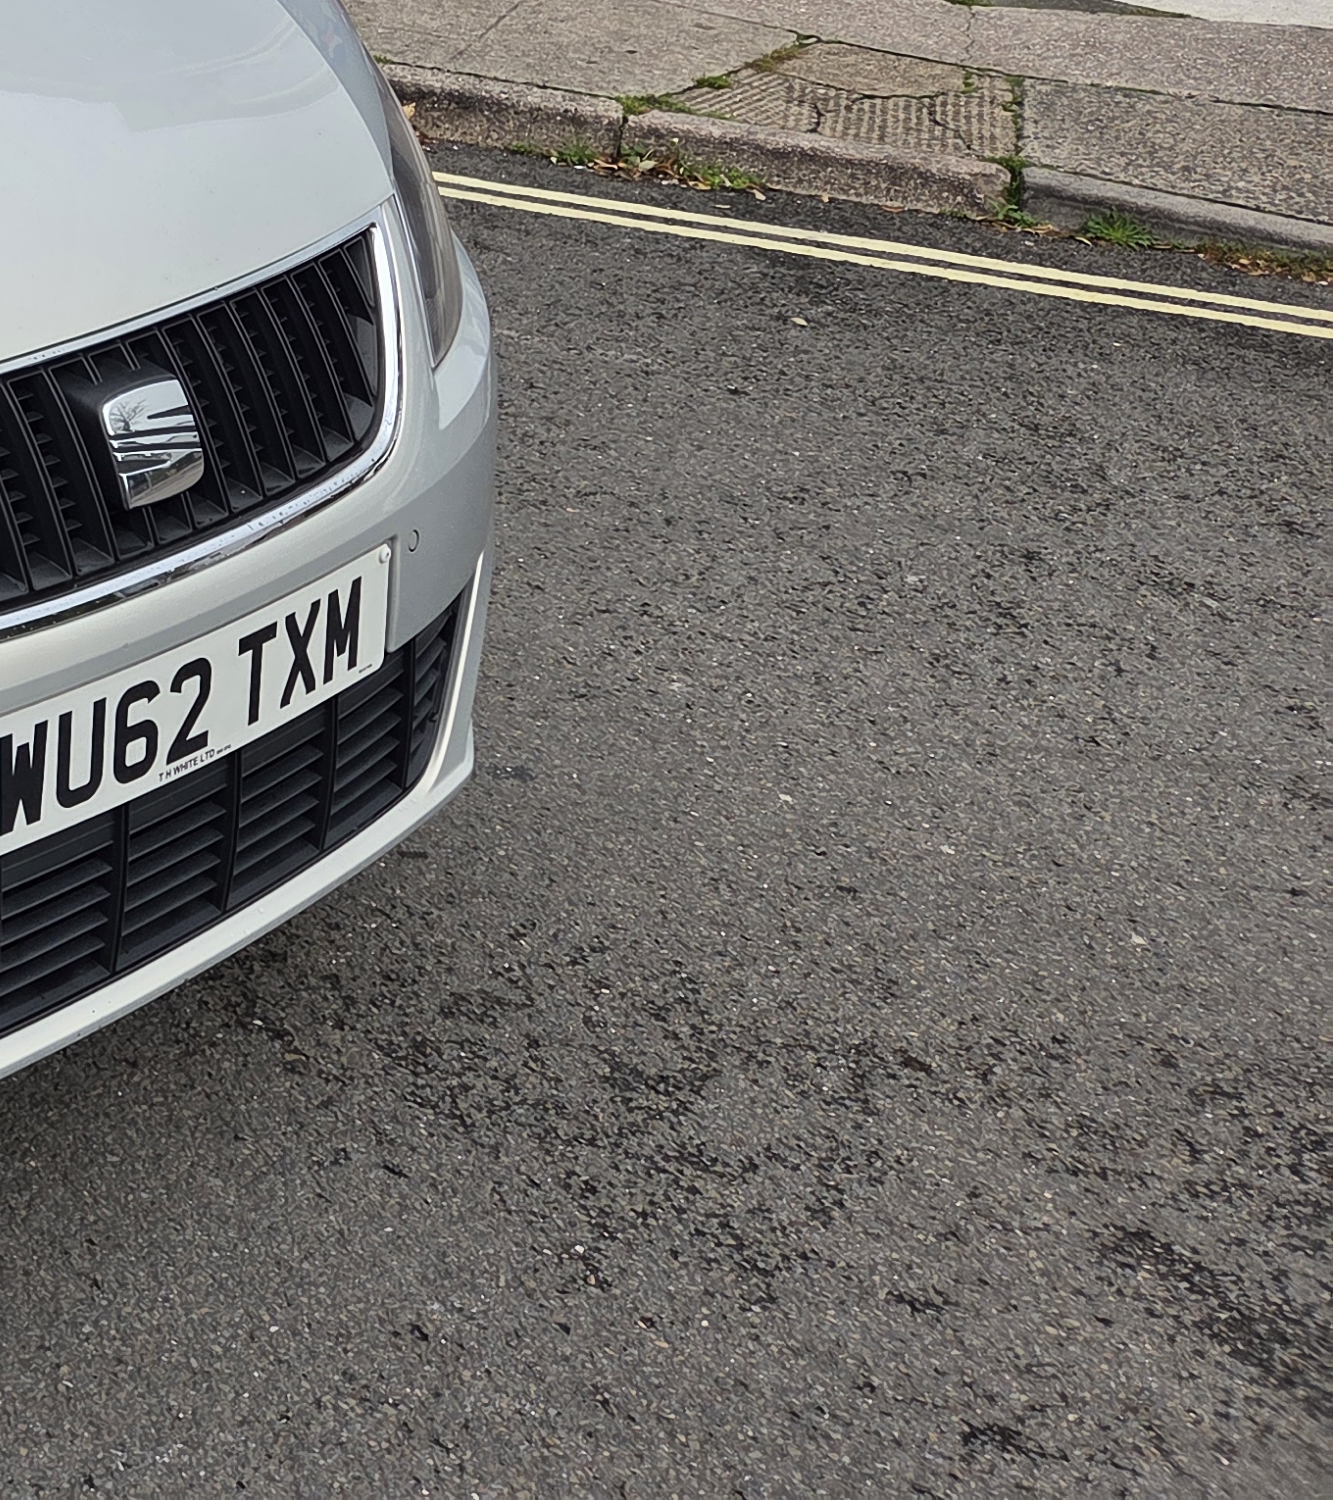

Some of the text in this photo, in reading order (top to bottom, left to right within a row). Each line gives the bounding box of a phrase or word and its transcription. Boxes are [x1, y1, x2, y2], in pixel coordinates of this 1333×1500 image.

[0, 576, 363, 837] WU62 TXM
[173, 756, 198, 775] WHITE
[200, 748, 215, 763] LTD
